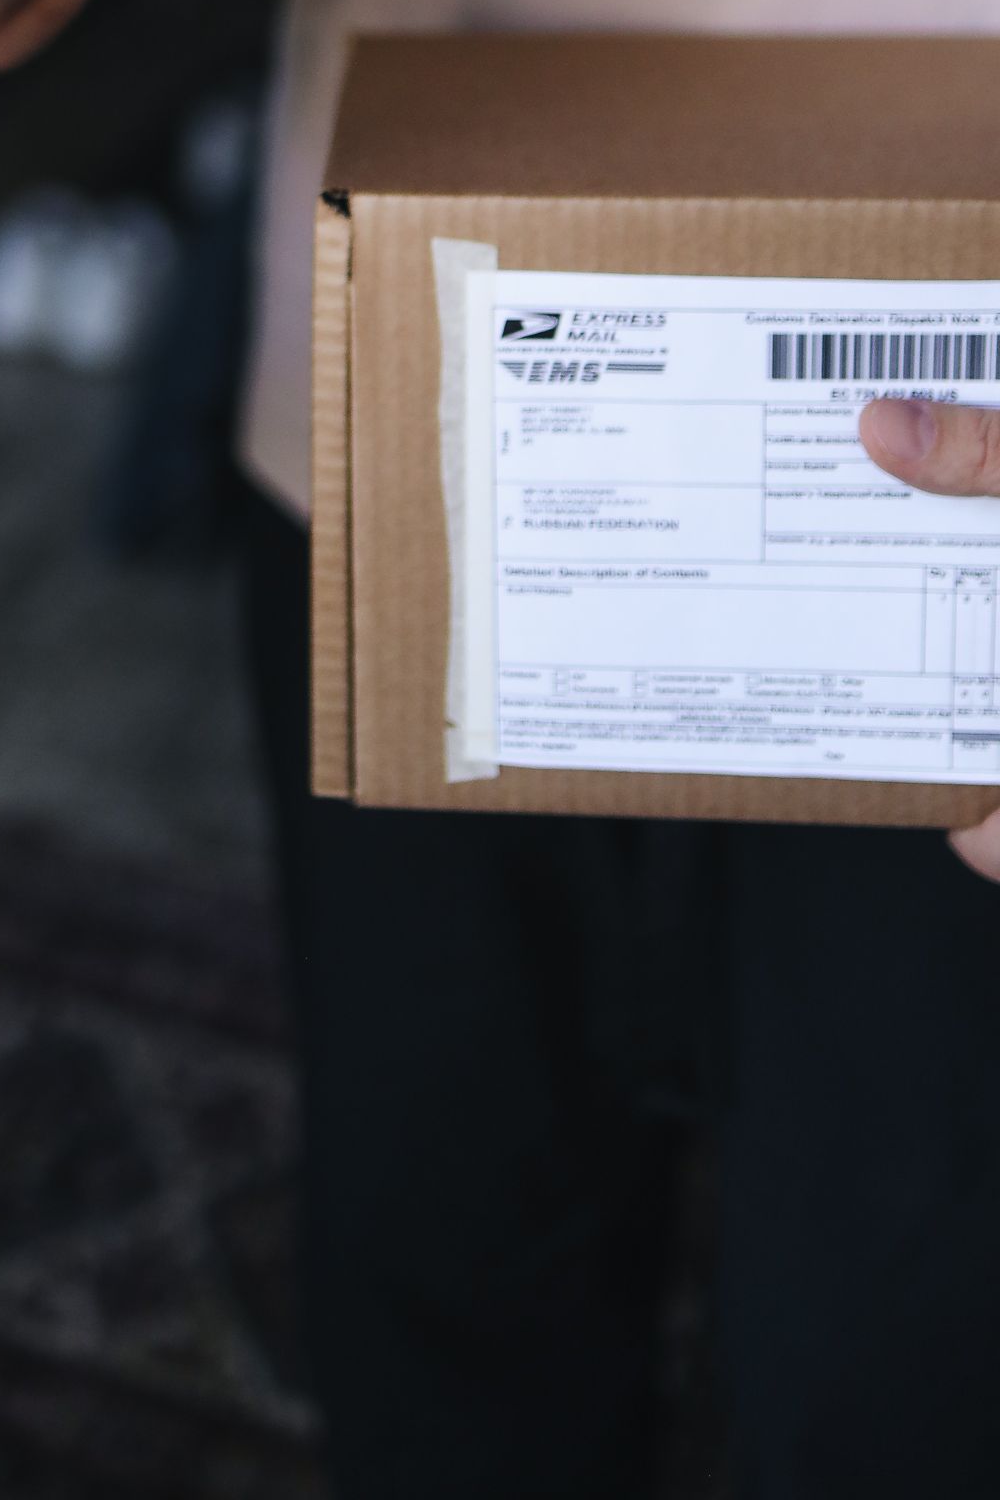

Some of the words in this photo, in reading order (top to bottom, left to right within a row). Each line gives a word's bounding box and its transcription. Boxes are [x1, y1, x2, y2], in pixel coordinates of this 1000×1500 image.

[572, 311, 667, 326] EXPRESS
[746, 312, 805, 324] Customs
[567, 330, 619, 343] MAIL
[528, 360, 601, 384] EMS
[523, 518, 585, 530] RUSSIAN
[588, 518, 680, 531] FEDERATION
